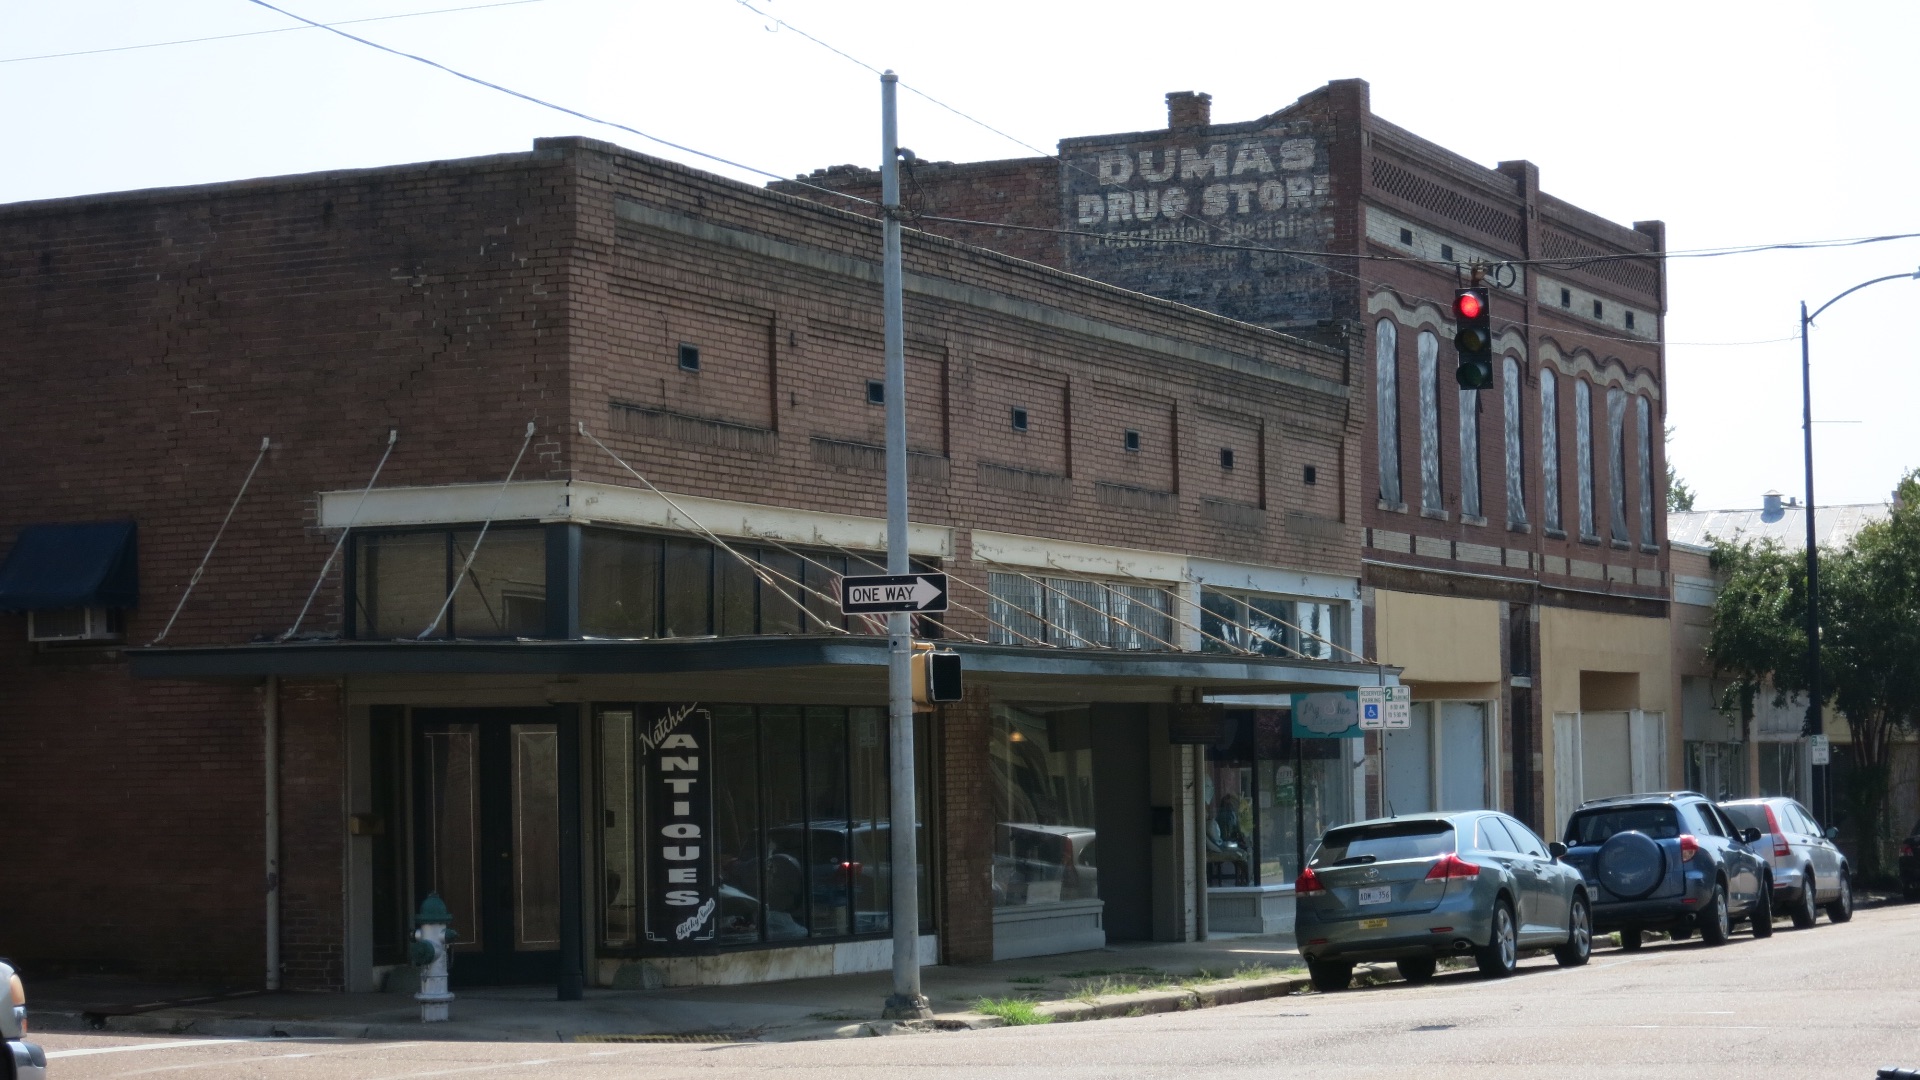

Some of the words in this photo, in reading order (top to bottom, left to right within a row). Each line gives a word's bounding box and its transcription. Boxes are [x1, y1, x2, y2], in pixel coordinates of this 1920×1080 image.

[1098, 138, 1317, 186] DUMAS
[1078, 186, 1190, 225] DRUG
[1080, 222, 1210, 250] rescription
[853, 588, 880, 602] ONE
[885, 587, 915, 601] WAY
[1303, 702, 1320, 719] My
[1386, 689, 1391, 700] 2
[639, 701, 698, 755] Natchez
[660, 734, 701, 906] ANTIQUES
